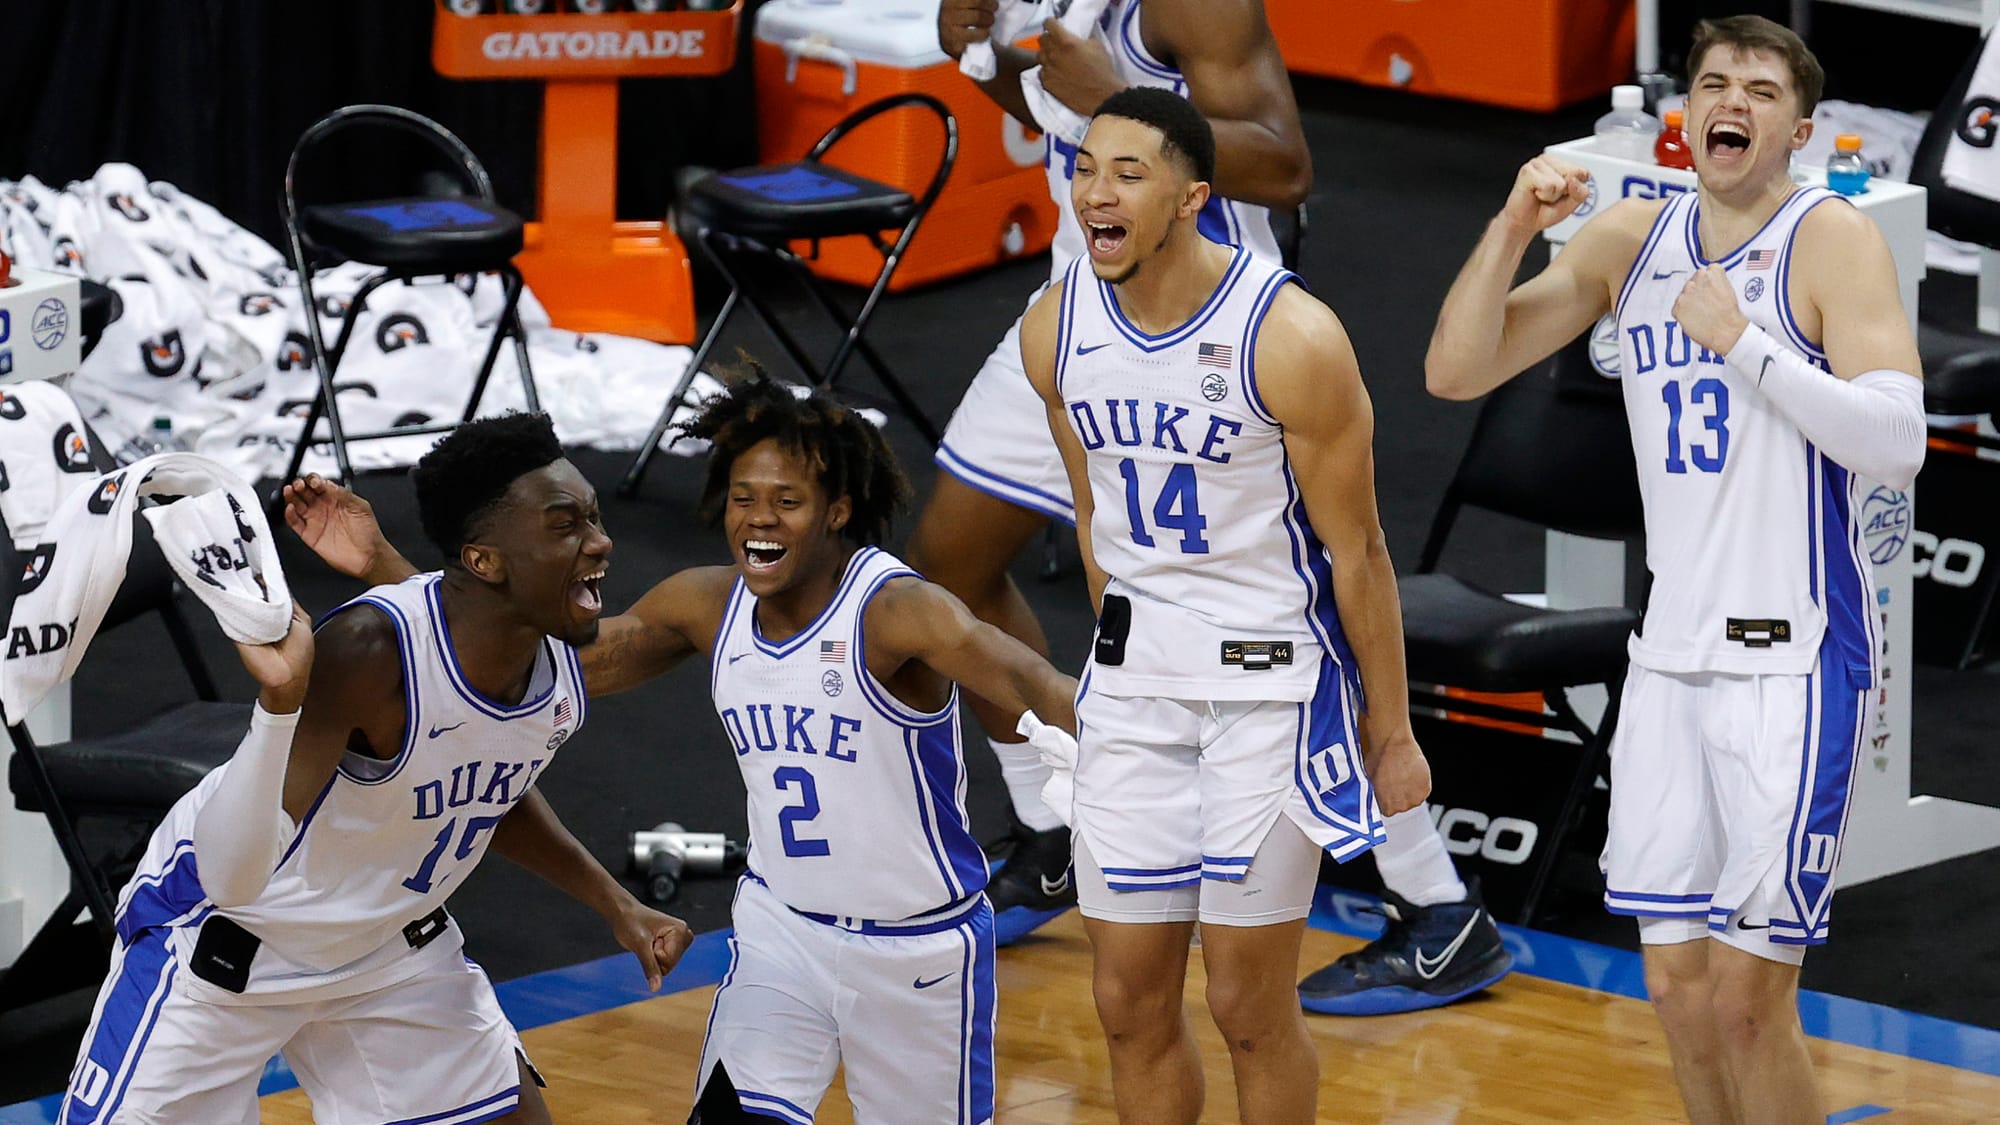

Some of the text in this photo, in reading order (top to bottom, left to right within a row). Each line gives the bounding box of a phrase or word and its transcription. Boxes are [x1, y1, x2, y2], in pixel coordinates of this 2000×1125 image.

[482, 30, 705, 60] GATORADE
[1071, 399, 1243, 464] DUKE
[1661, 378, 1729, 474] 13
[1119, 458, 1210, 554] 14
[1866, 505, 1908, 532] ACC
[1275, 648, 1288, 658] 44
[722, 704, 861, 763] DUKE
[773, 766, 831, 857] 2
